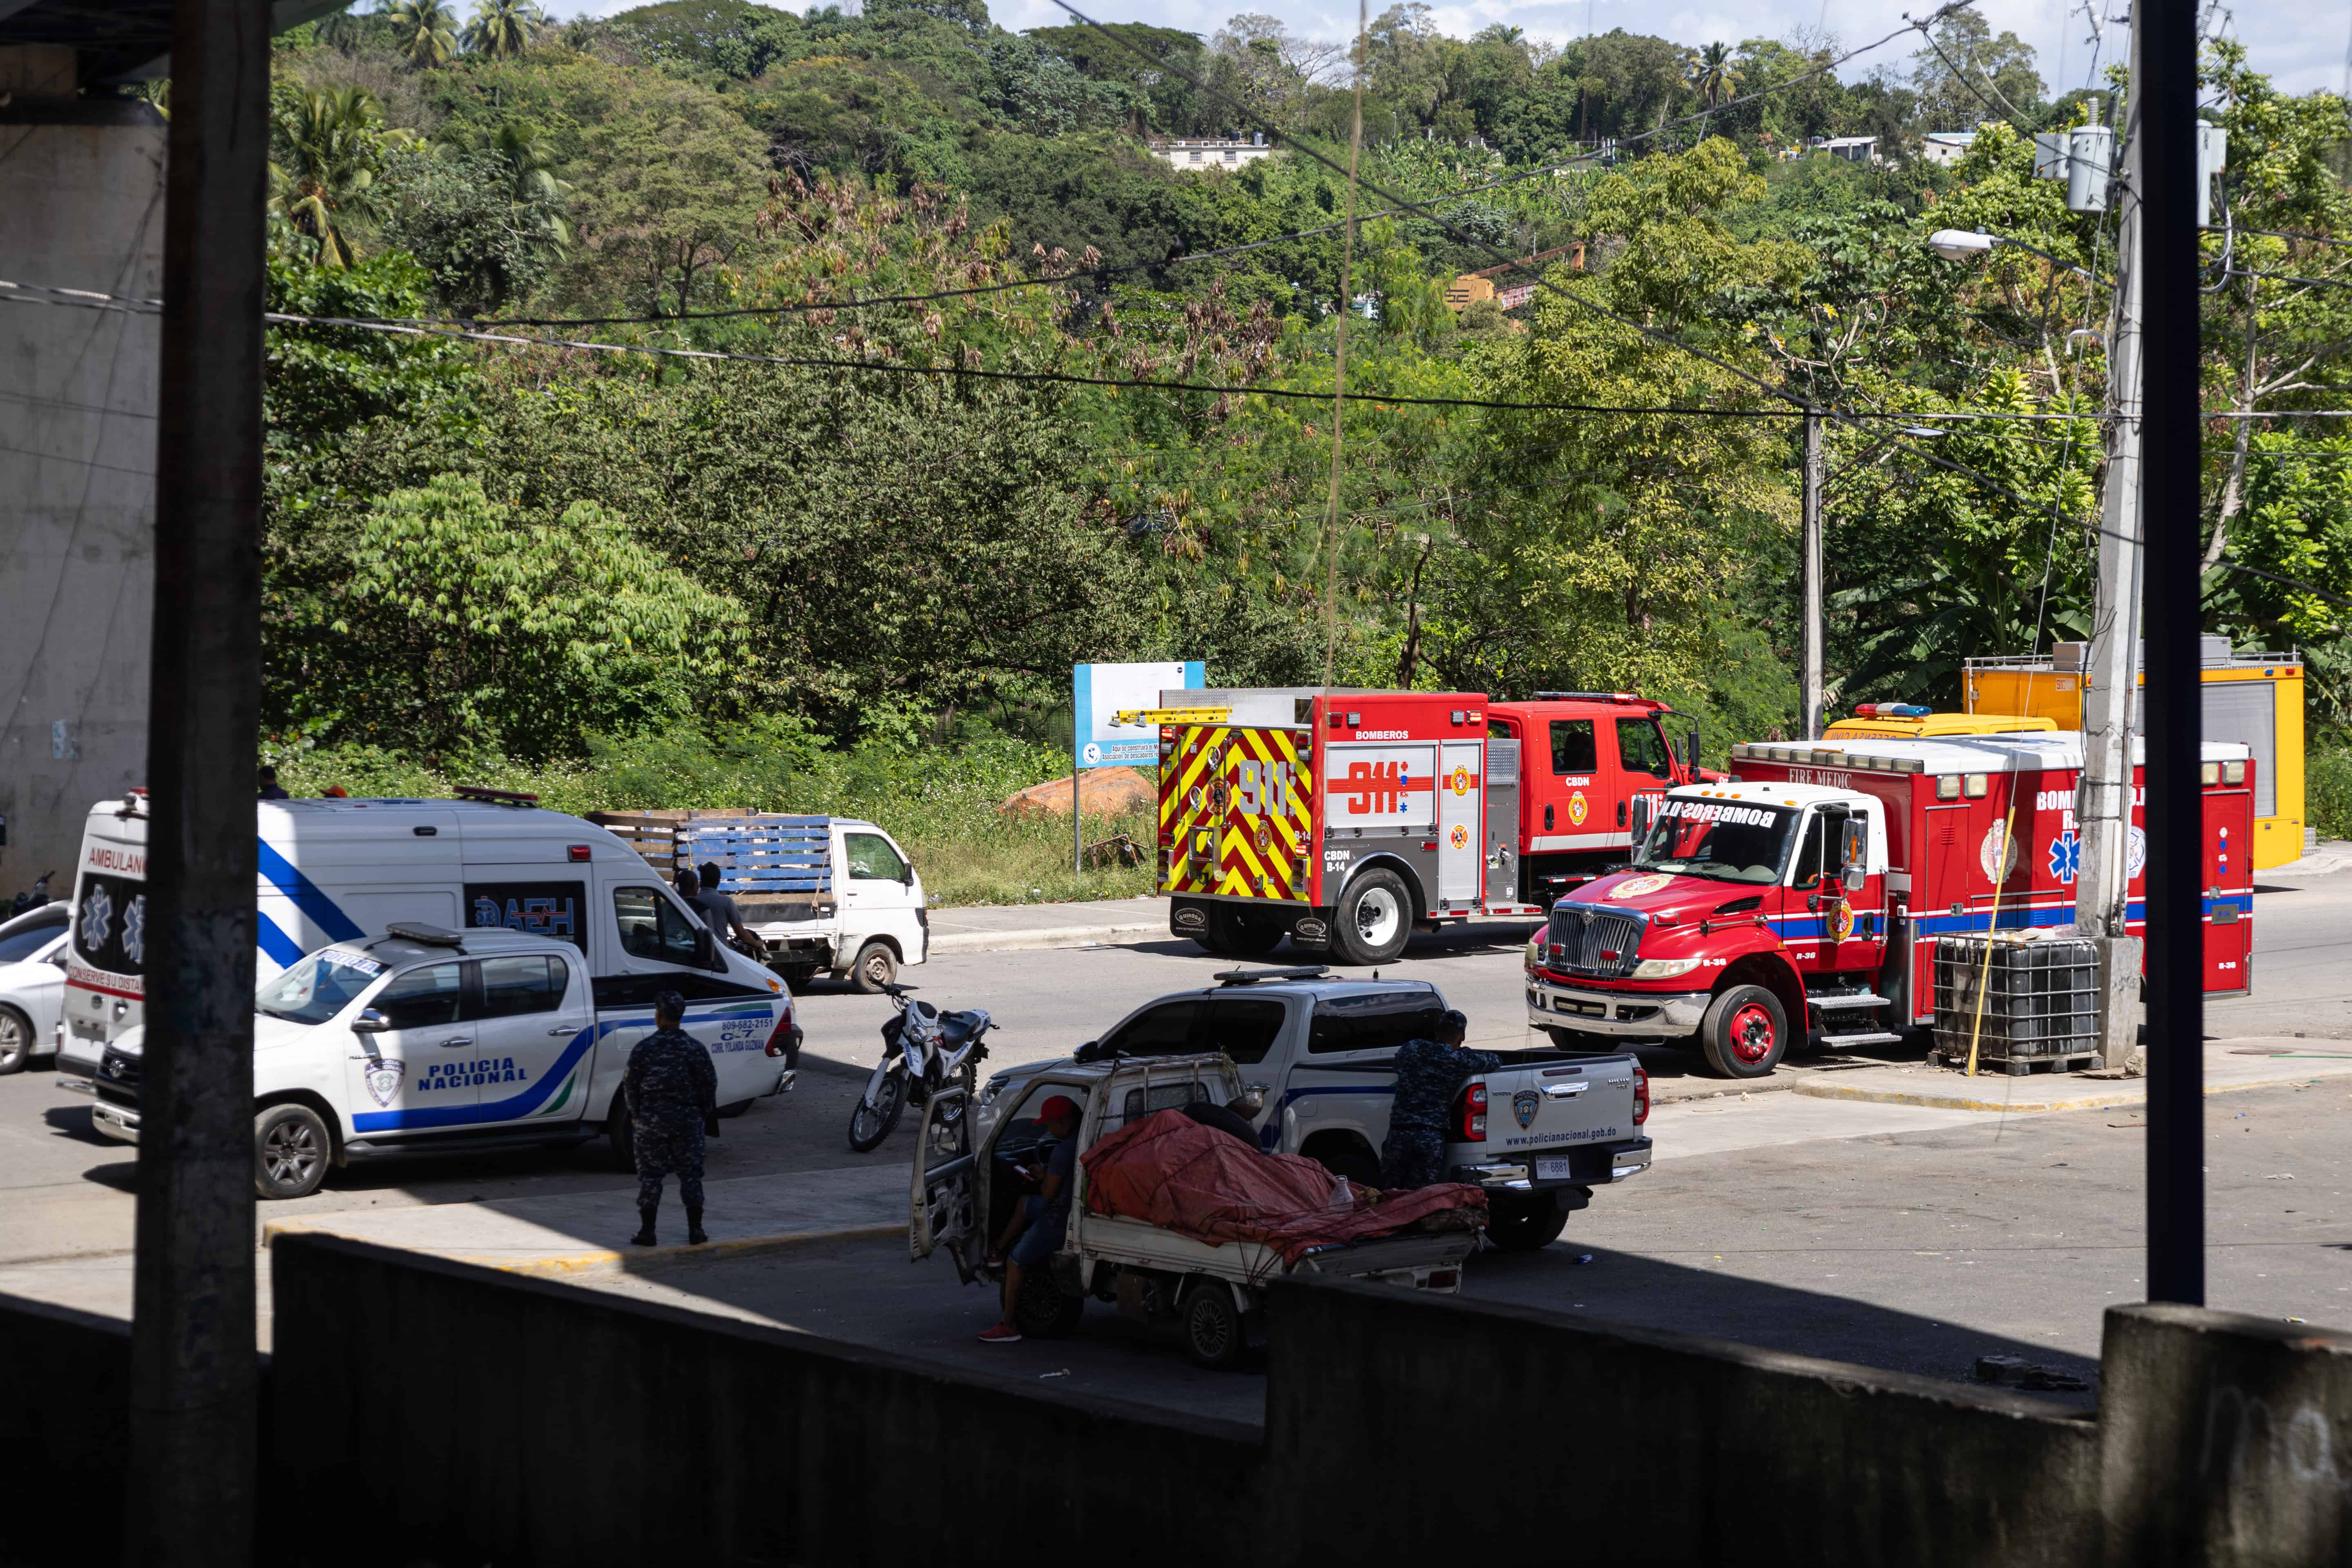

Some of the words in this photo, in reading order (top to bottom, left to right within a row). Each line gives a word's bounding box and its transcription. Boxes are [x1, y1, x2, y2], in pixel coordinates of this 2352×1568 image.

[1355, 731, 1409, 740] BOMBEROS
[1566, 776, 1590, 786] CBDN
[1789, 768, 1812, 785] FIRE
[1817, 771, 1852, 789] MEDIC
[1239, 760, 1286, 816] 911
[1348, 762, 1398, 814] 911
[1295, 830, 1311, 841] B-14
[1324, 850, 1350, 861] CBDN
[1327, 861, 1345, 872] B-14
[1179, 913, 1201, 922] QUIROGA
[1300, 923, 1322, 932] QUIROGA
[1703, 958, 1727, 967] R-36
[2218, 961, 2236, 970] R-36
[68, 965, 105, 985] CONSERVE
[106, 974, 116, 987] SU
[722, 1018, 773, 1030] 809-682-2151
[720, 1029, 754, 1041] C-7
[428, 1057, 514, 1077] POLICIA
[418, 1068, 527, 1091] NACIONAL
[1506, 1127, 1616, 1146] www.policianacional.gob.do
